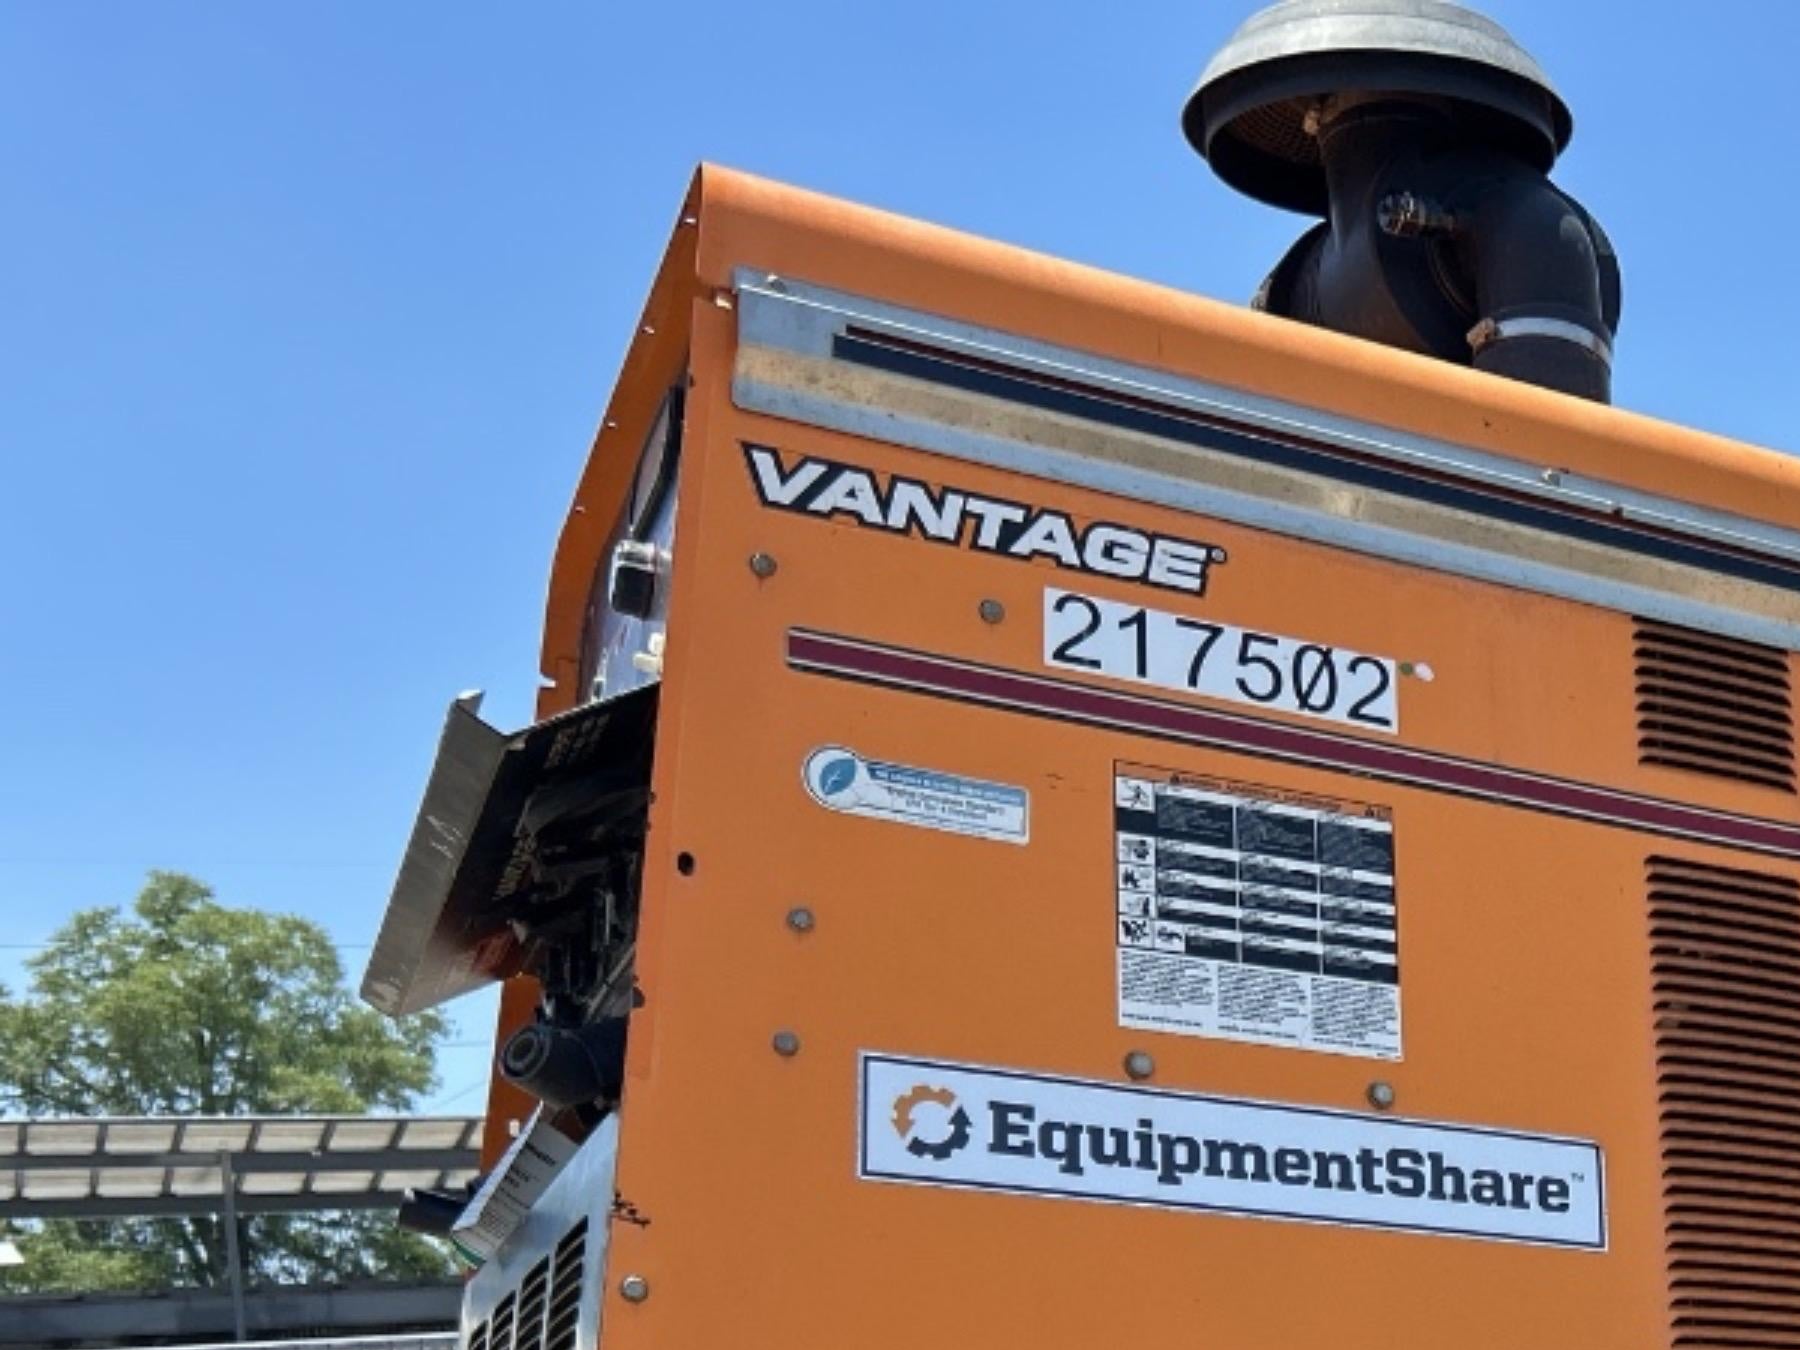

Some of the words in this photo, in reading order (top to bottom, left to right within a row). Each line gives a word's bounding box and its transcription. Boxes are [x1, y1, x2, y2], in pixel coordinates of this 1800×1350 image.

[745, 446, 1208, 597] VANTAGE
[1051, 592, 1394, 728] 217502
[986, 1101, 1571, 1215] EquipmentShare
